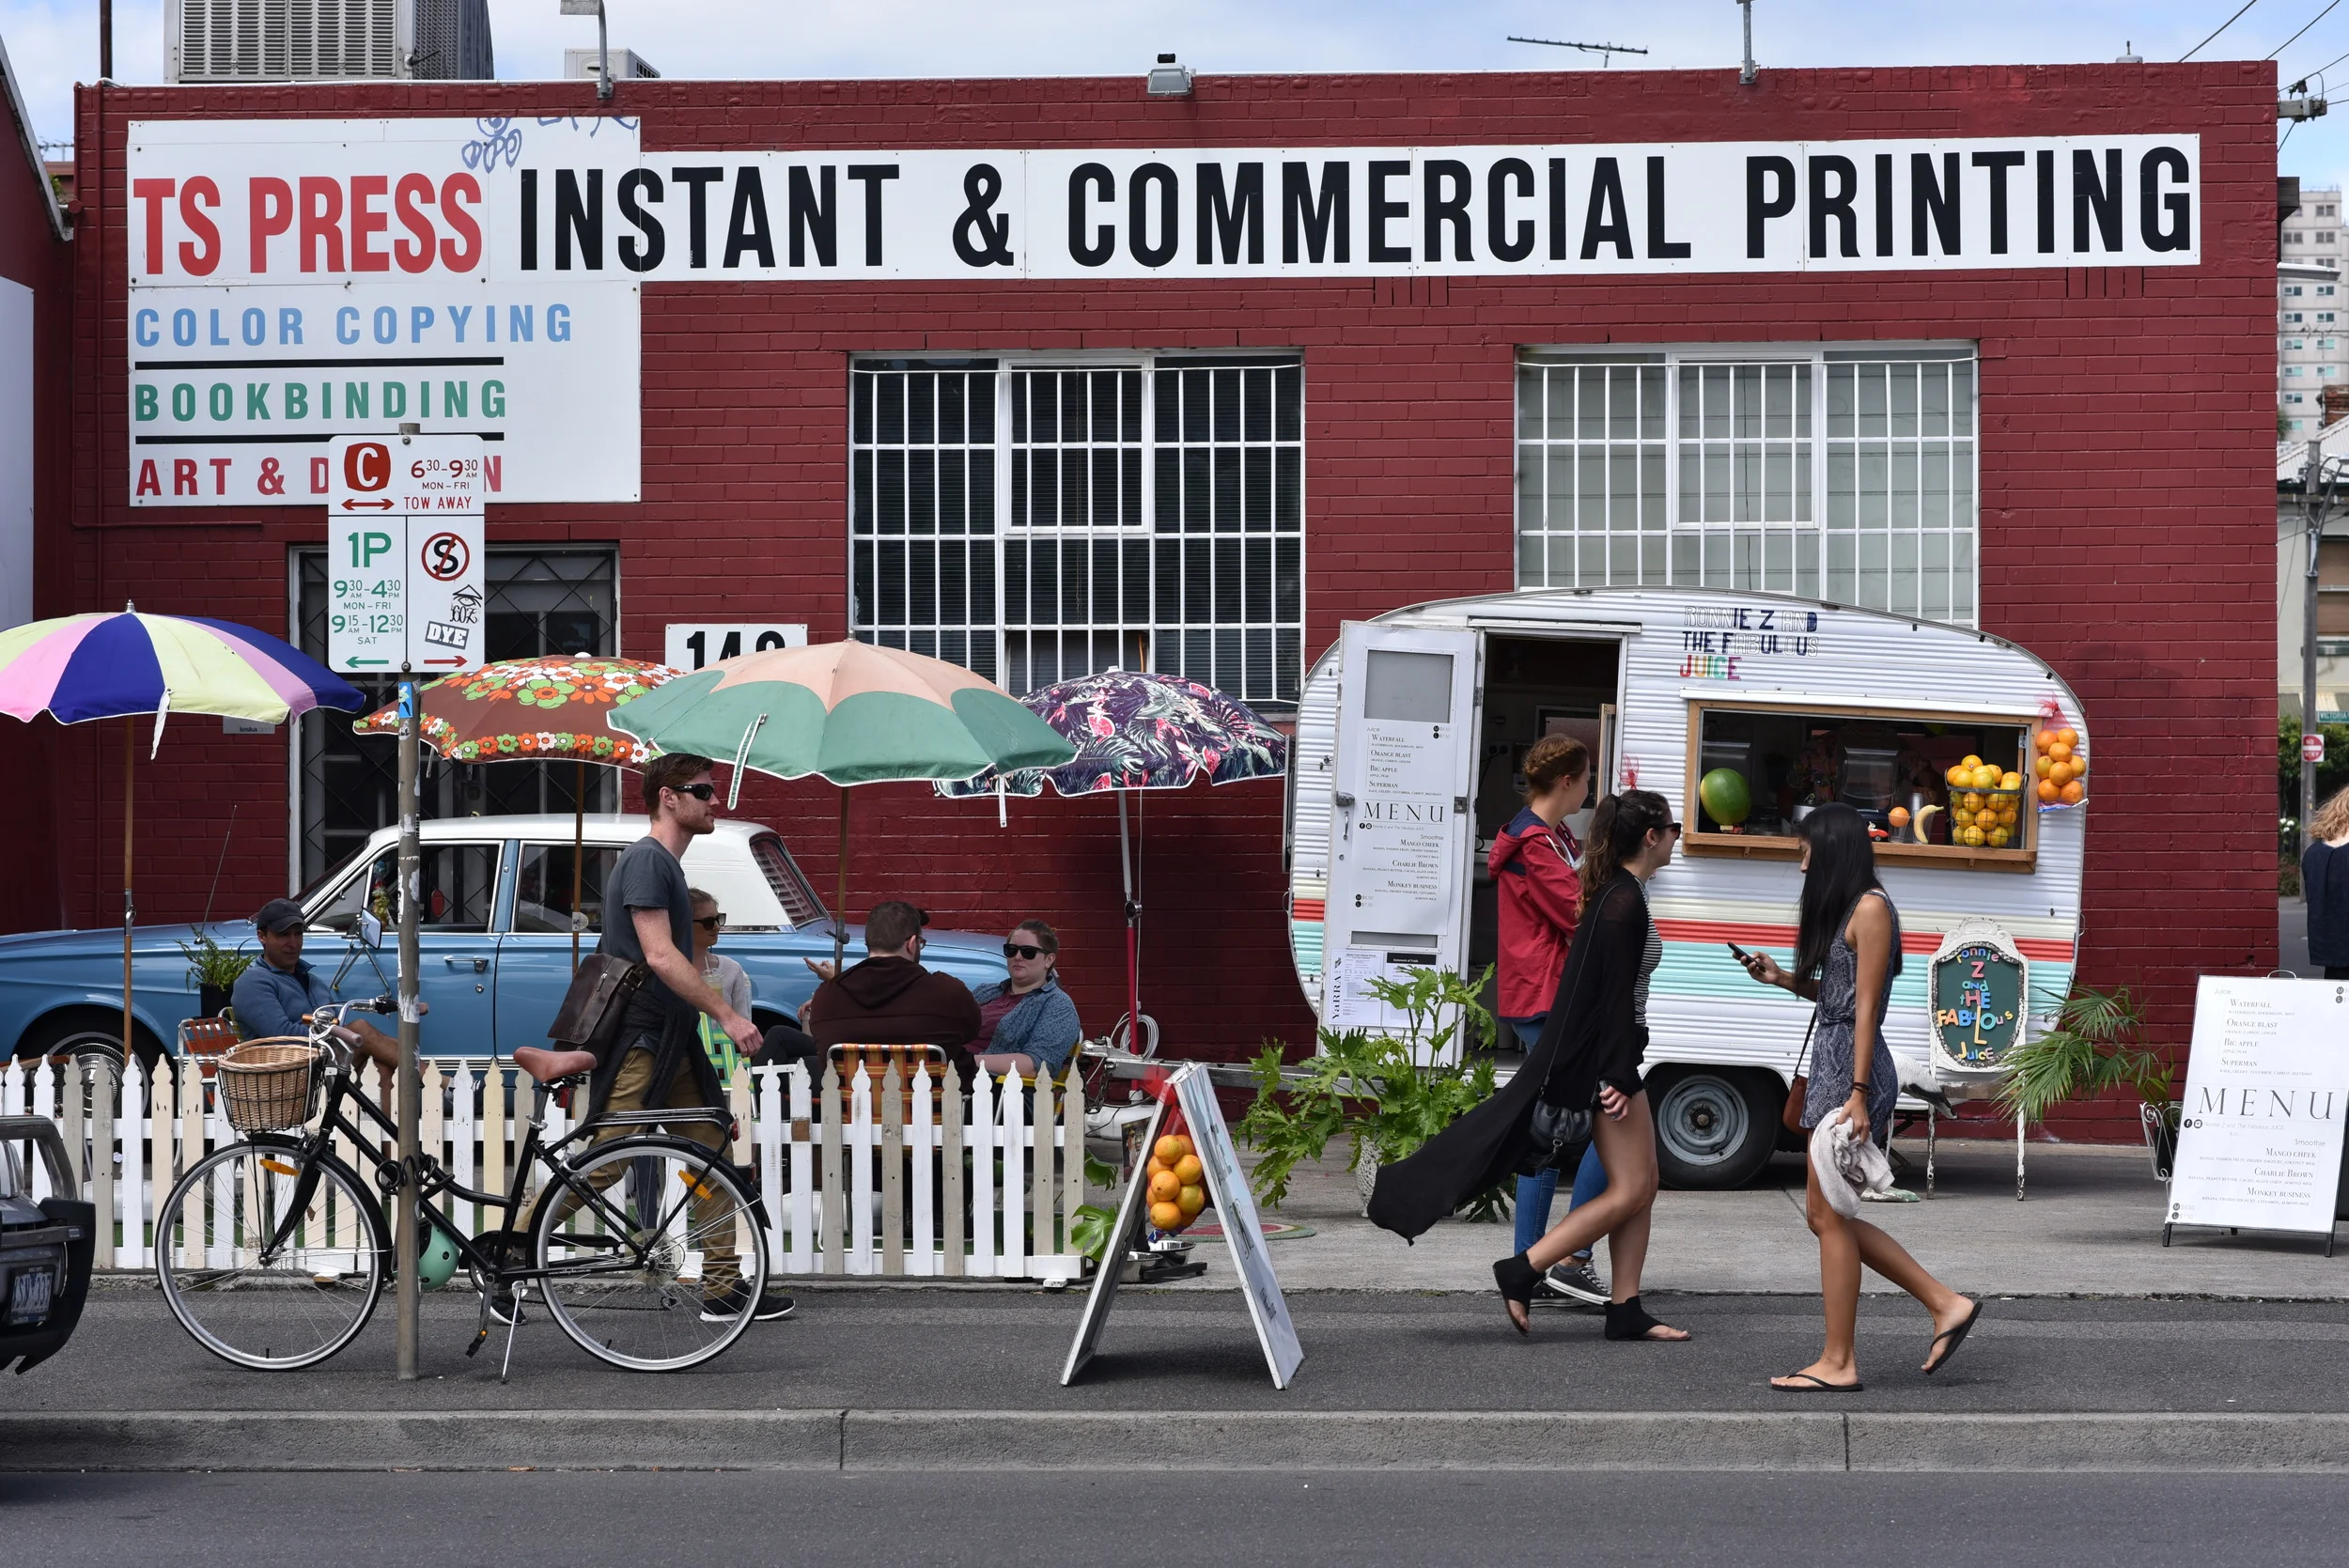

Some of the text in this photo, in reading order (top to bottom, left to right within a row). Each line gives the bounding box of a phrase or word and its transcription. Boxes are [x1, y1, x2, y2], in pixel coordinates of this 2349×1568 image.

[133, 146, 2192, 276] TS PRESS INSTANT & COMMERCIAL PRINTING
[135, 303, 571, 347] COLOR COPYING
[135, 380, 506, 422] BOOKBINDING
[136, 458, 232, 496] ART
[258, 457, 285, 495] &
[404, 496, 472, 510] TOW AWAY
[348, 532, 392, 568] 1P
[1684, 606, 1817, 632] RONNIE Z AND
[1682, 631, 1819, 657] THE FABULOUS
[1680, 655, 1742, 681] JUICE
[1363, 802, 1444, 822] MENU
[1388, 880, 1412, 889] MONKEY
[1956, 948, 1999, 964] ronnie
[1971, 961, 1984, 978] Z
[2230, 999, 2271, 1008] WATERFALL
[2227, 1018, 2256, 1028] ORANGE
[2224, 1037, 2236, 1047] BIG
[2221, 1057, 2258, 1066] SUPERMAN
[2198, 1087, 2334, 1120] MENU
[2265, 1148, 2292, 1157] MANGO
[2254, 1167, 2313, 1178] CHARLIE BROWN
[2247, 1188, 2278, 1197] MONKEY
